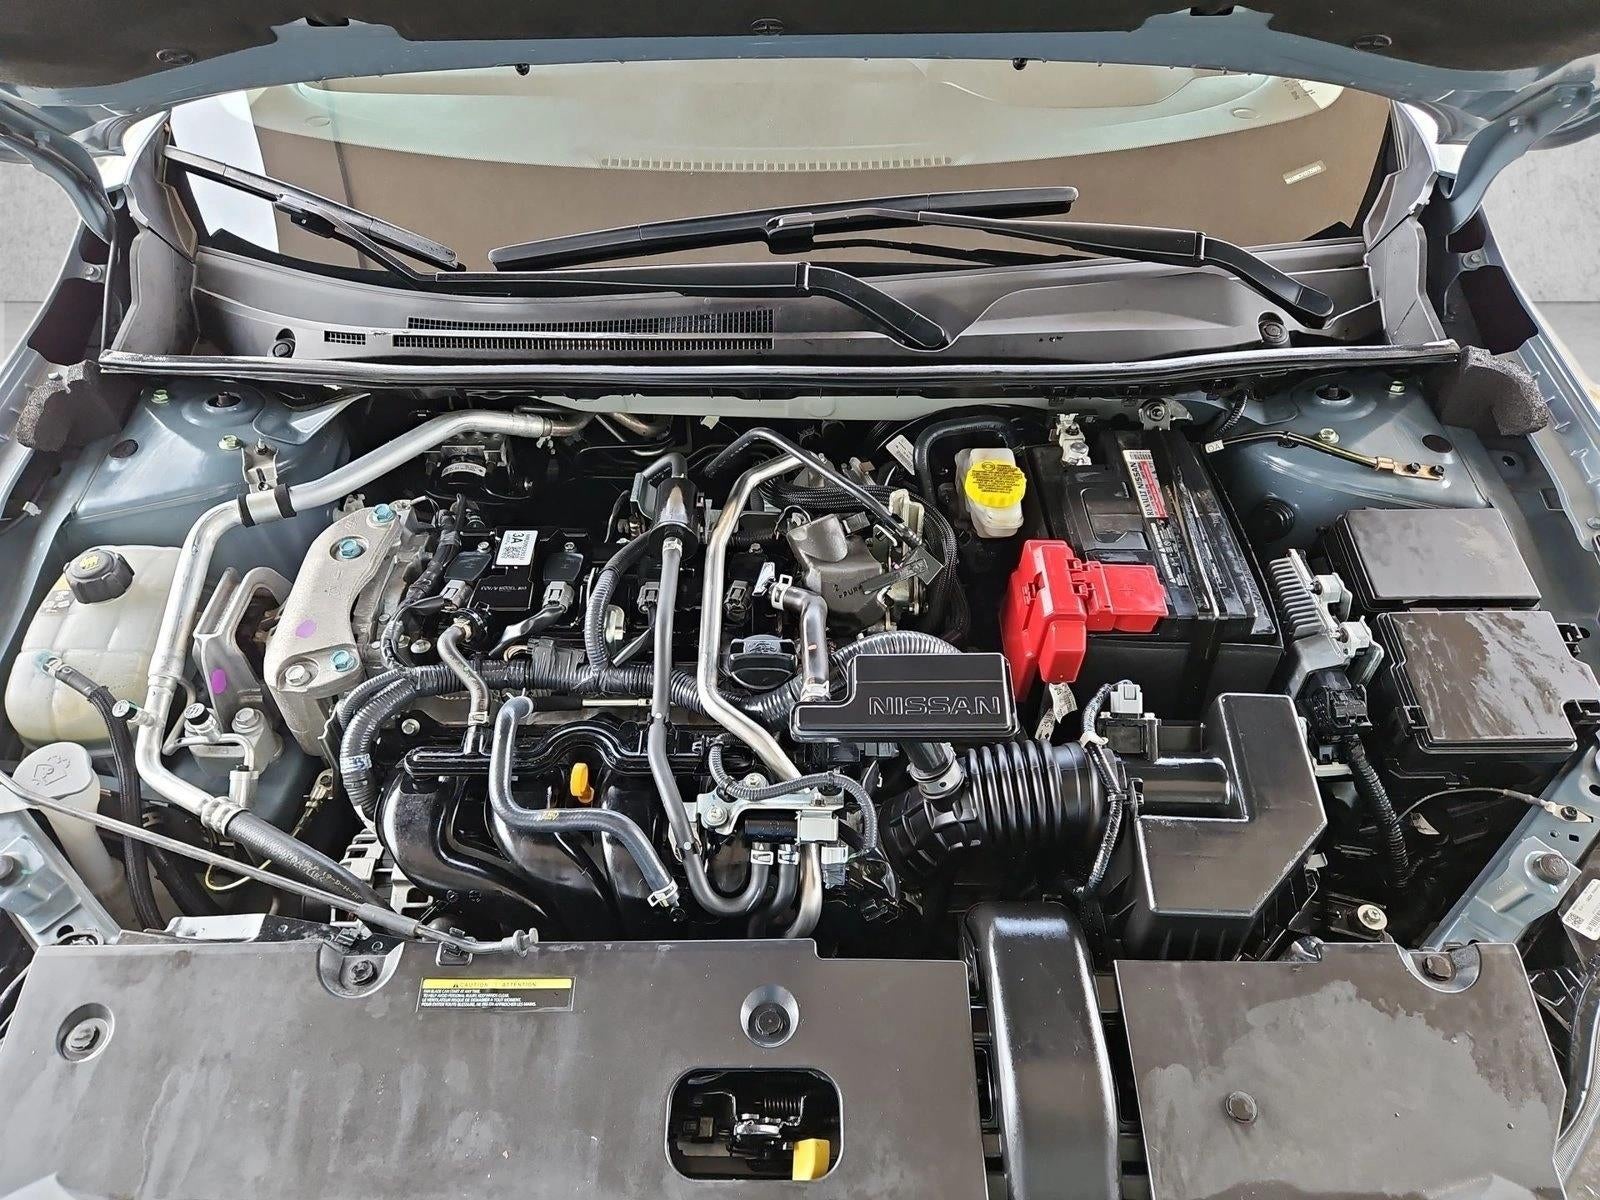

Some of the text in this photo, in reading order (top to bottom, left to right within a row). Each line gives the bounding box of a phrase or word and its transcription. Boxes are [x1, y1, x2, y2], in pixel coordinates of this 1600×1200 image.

[1130, 462, 1144, 489] NISSAN
[511, 533, 525, 544] 3A
[869, 697, 1001, 716] NISSAN
